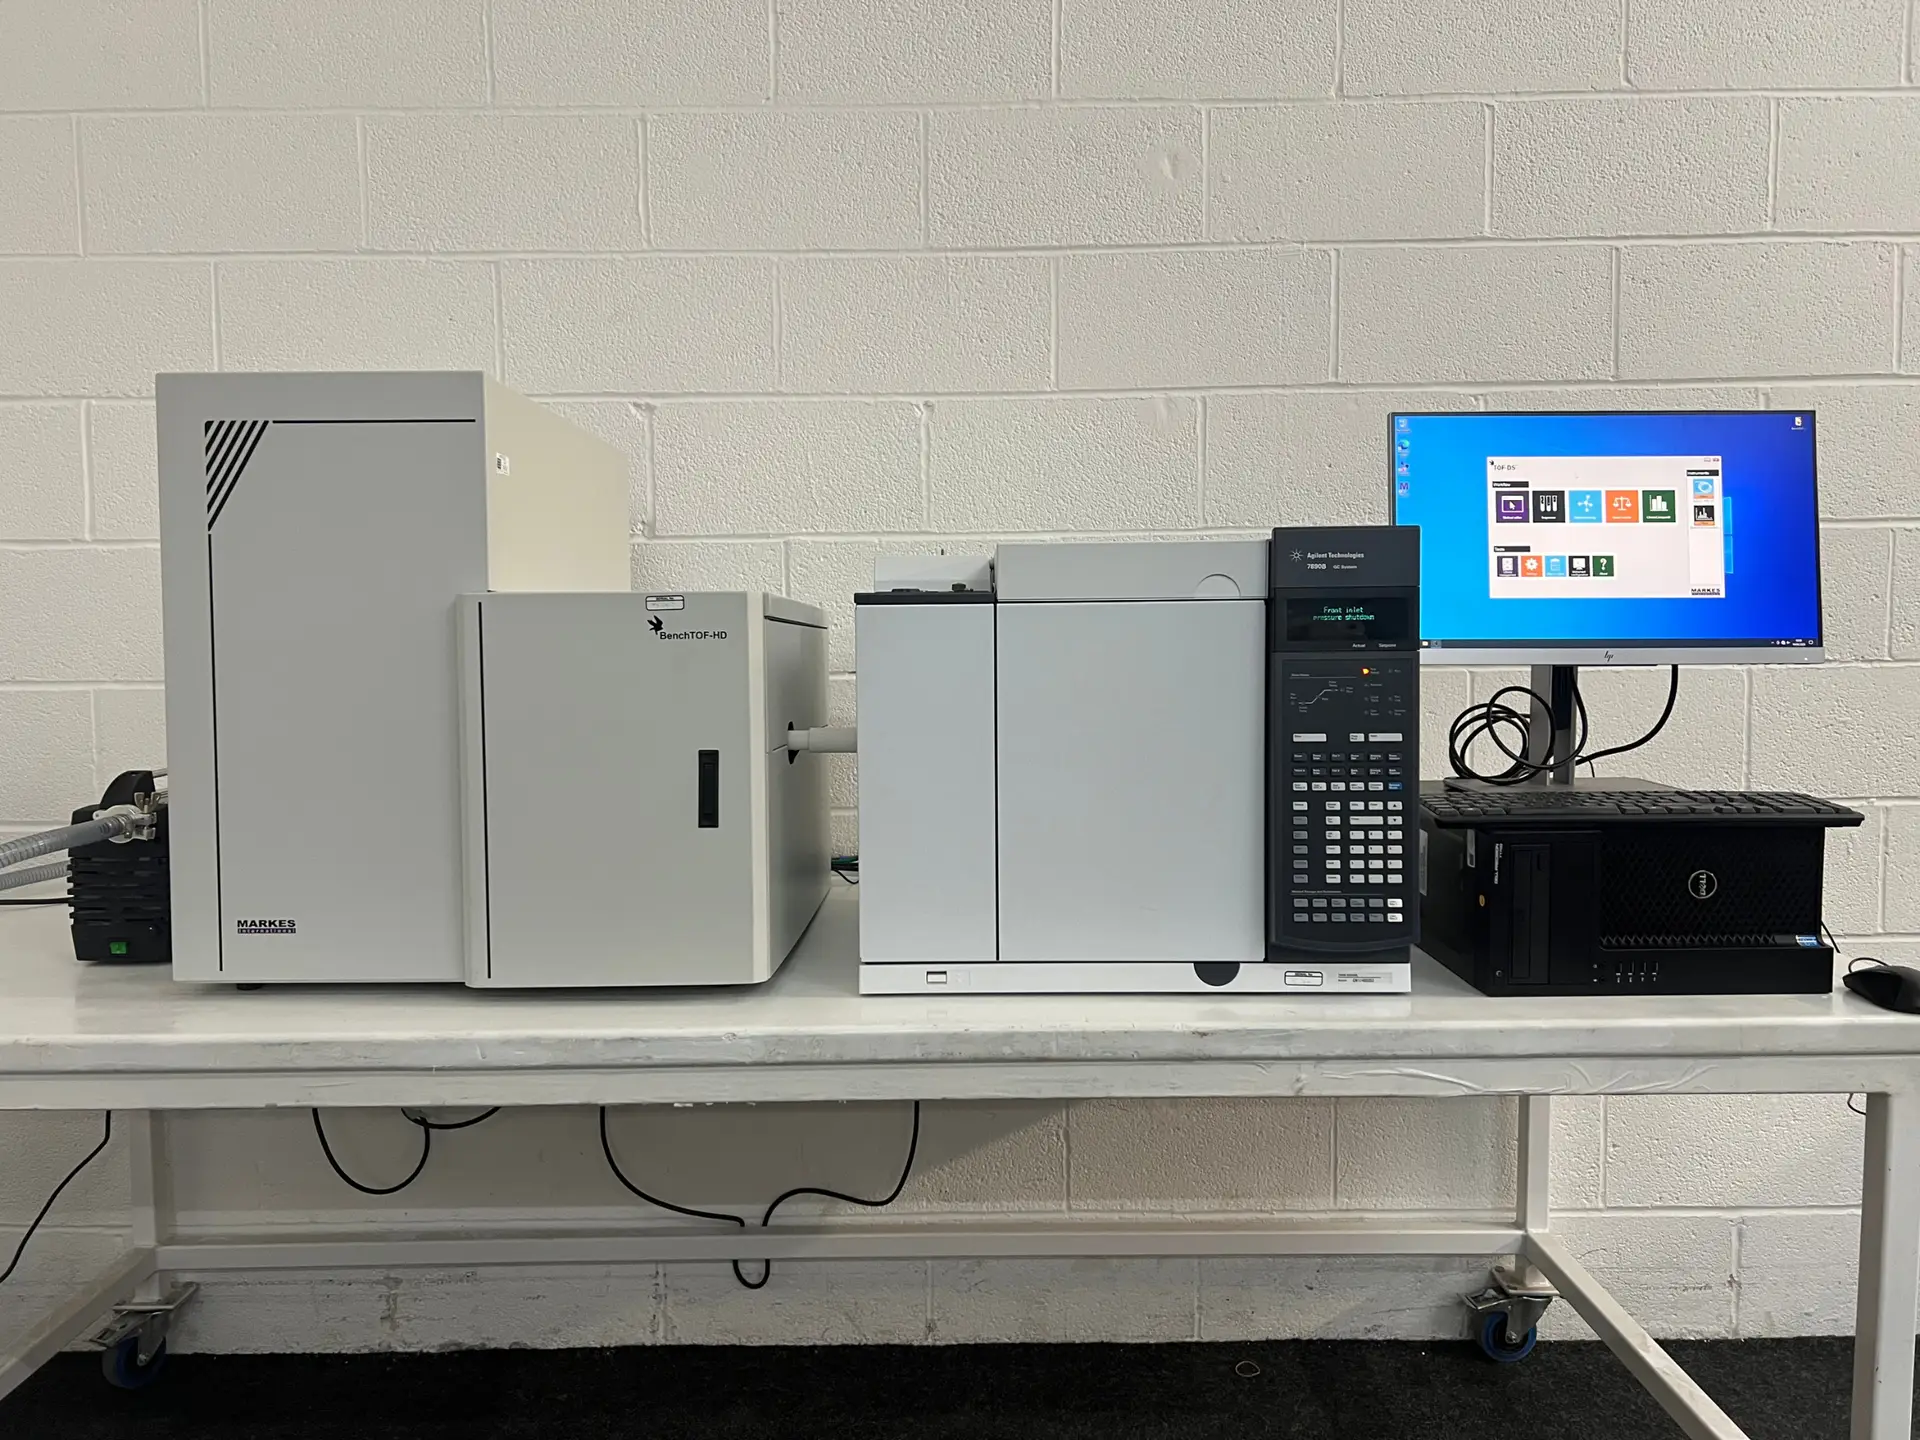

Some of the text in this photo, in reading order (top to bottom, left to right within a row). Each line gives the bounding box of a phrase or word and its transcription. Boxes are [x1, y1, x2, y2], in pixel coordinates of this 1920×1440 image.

[1307, 552, 1364, 560] Agilent Technologies
[1323, 606, 1364, 614] Front inlet
[1345, 613, 1375, 621] shutdown
[659, 631, 728, 640] BenchTOF-HD
[1698, 873, 1707, 896] DELL
[237, 919, 296, 928] MARKES
